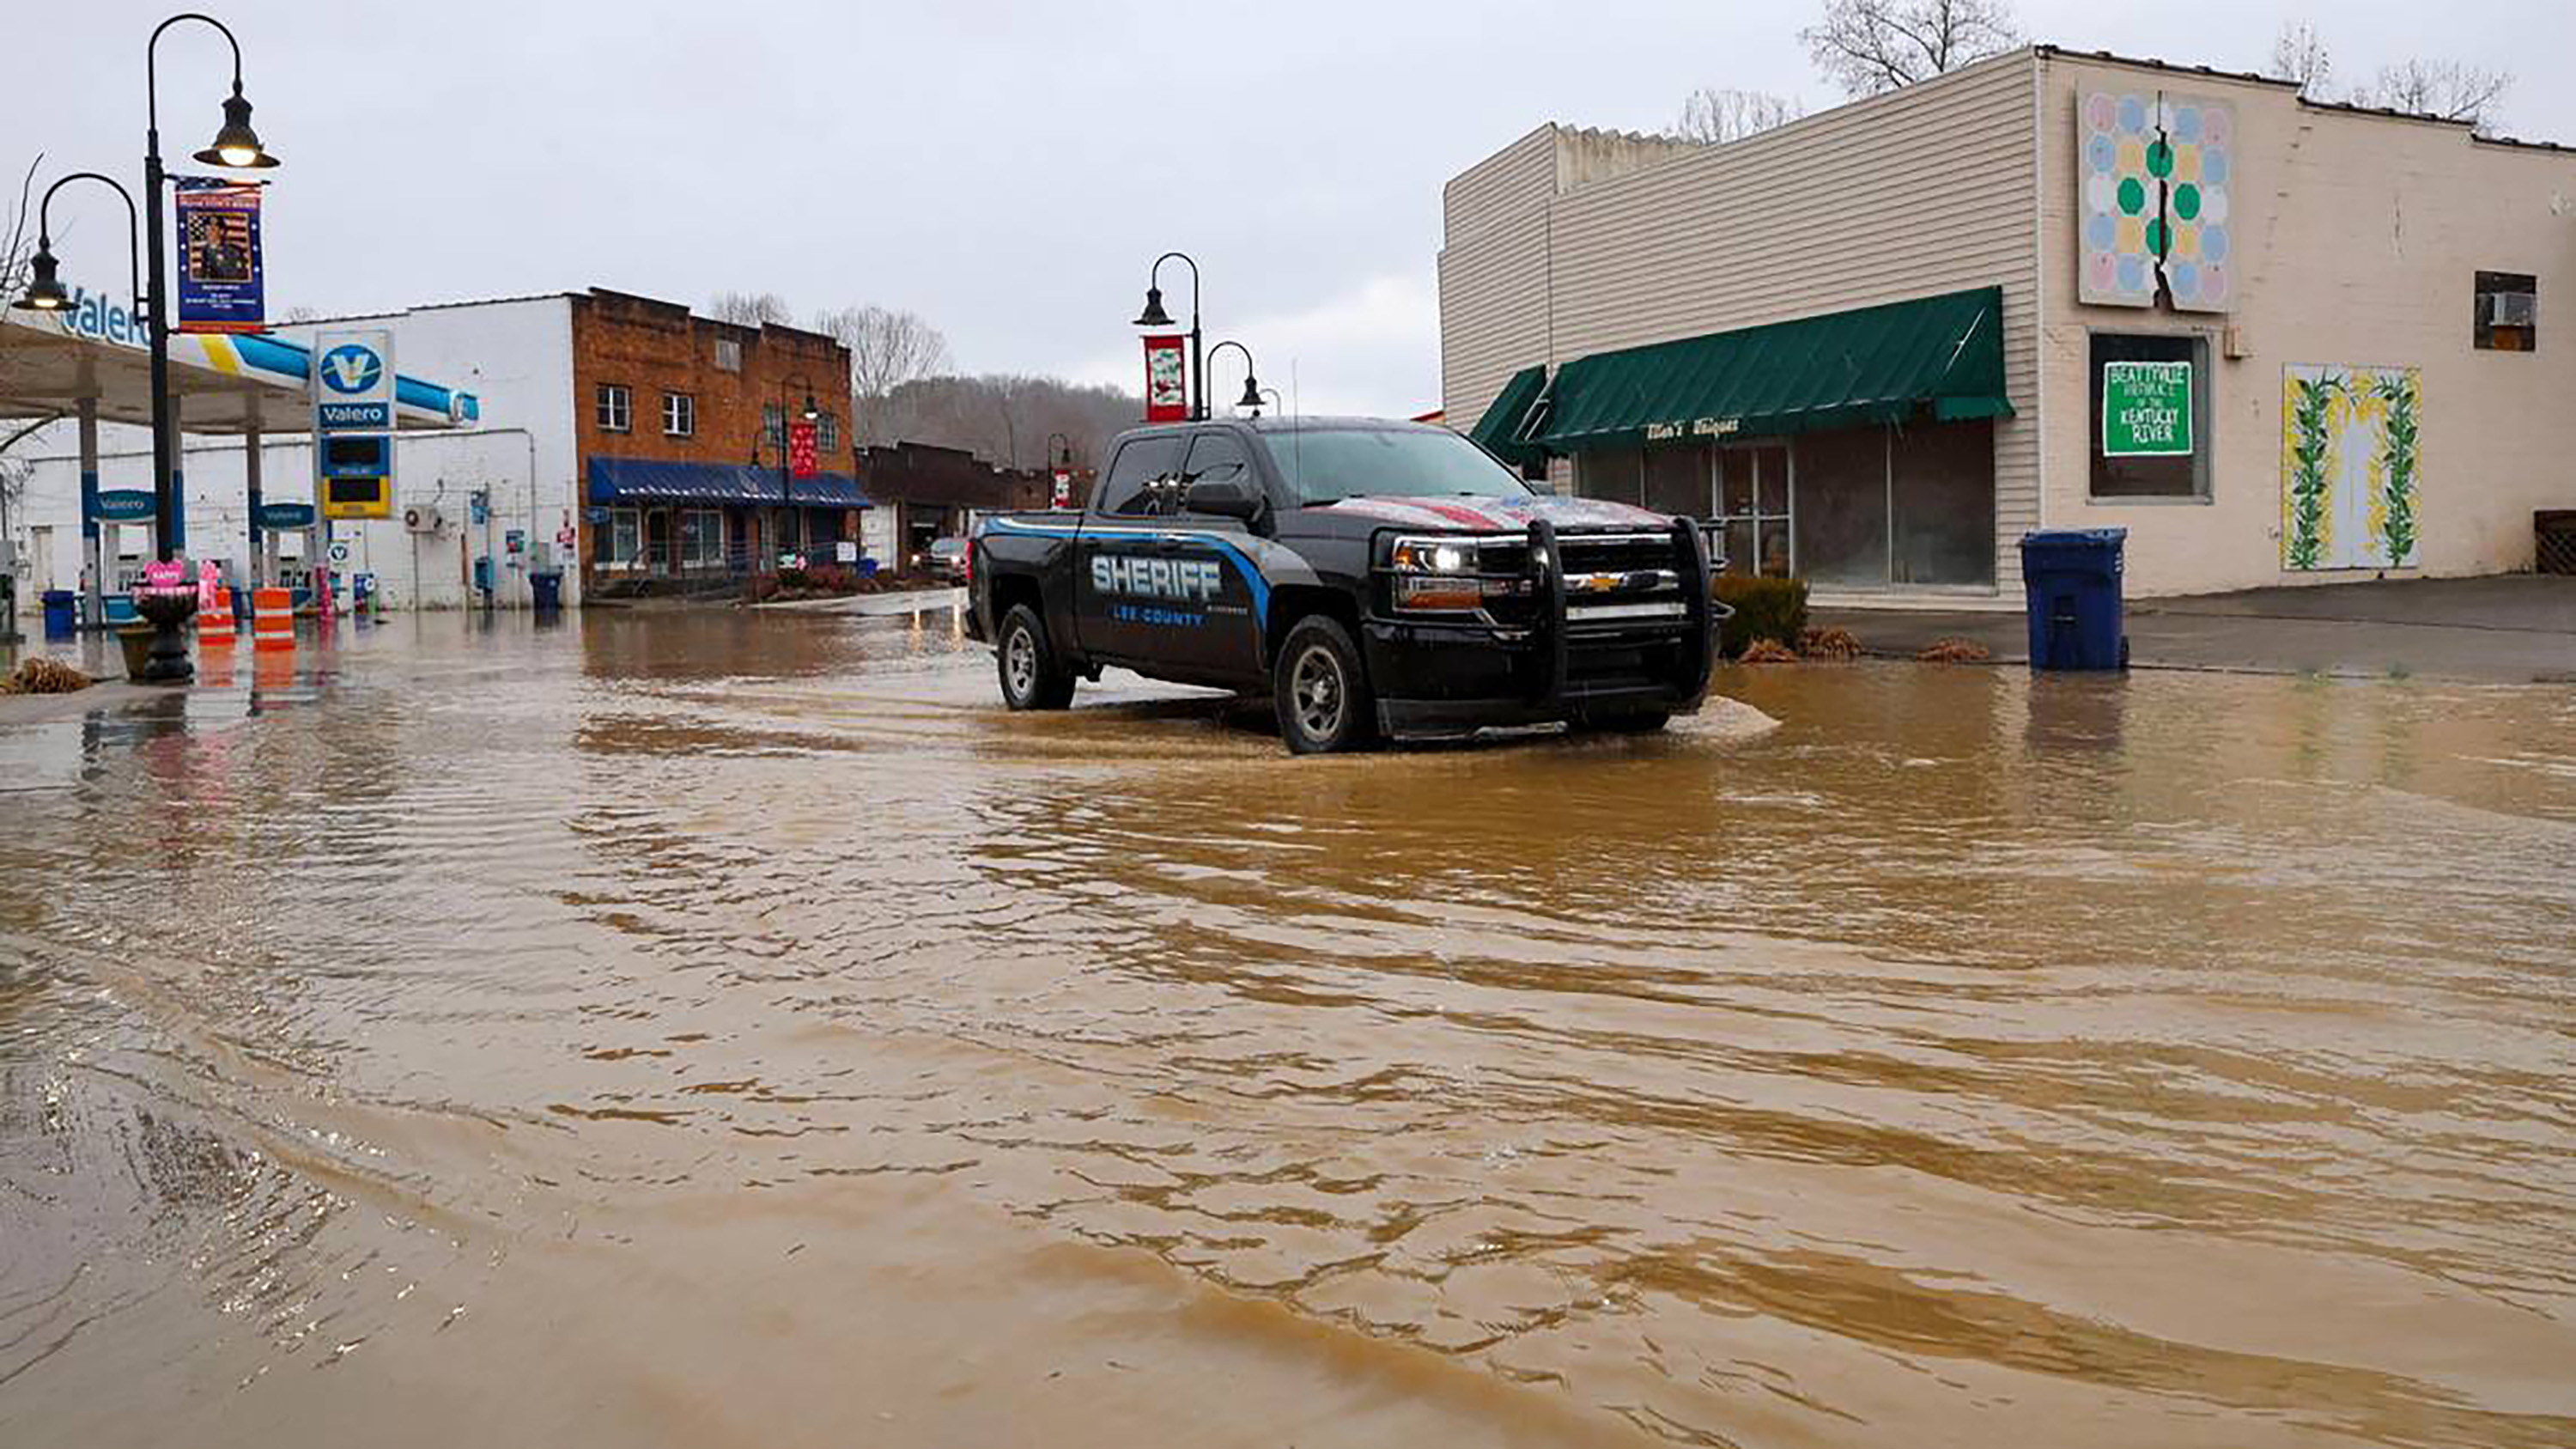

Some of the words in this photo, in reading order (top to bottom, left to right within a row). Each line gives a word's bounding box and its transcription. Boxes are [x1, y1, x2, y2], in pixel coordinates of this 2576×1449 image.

[324, 407, 383, 422] Valero
[2121, 409, 2178, 425] KENTUCKY
[2133, 424, 2172, 443] RIVER
[100, 498, 145, 509] Valero
[1092, 555, 1222, 601] SHERIFF
[1114, 604, 1138, 621] LEE
[1143, 606, 1206, 625] COUNTY
